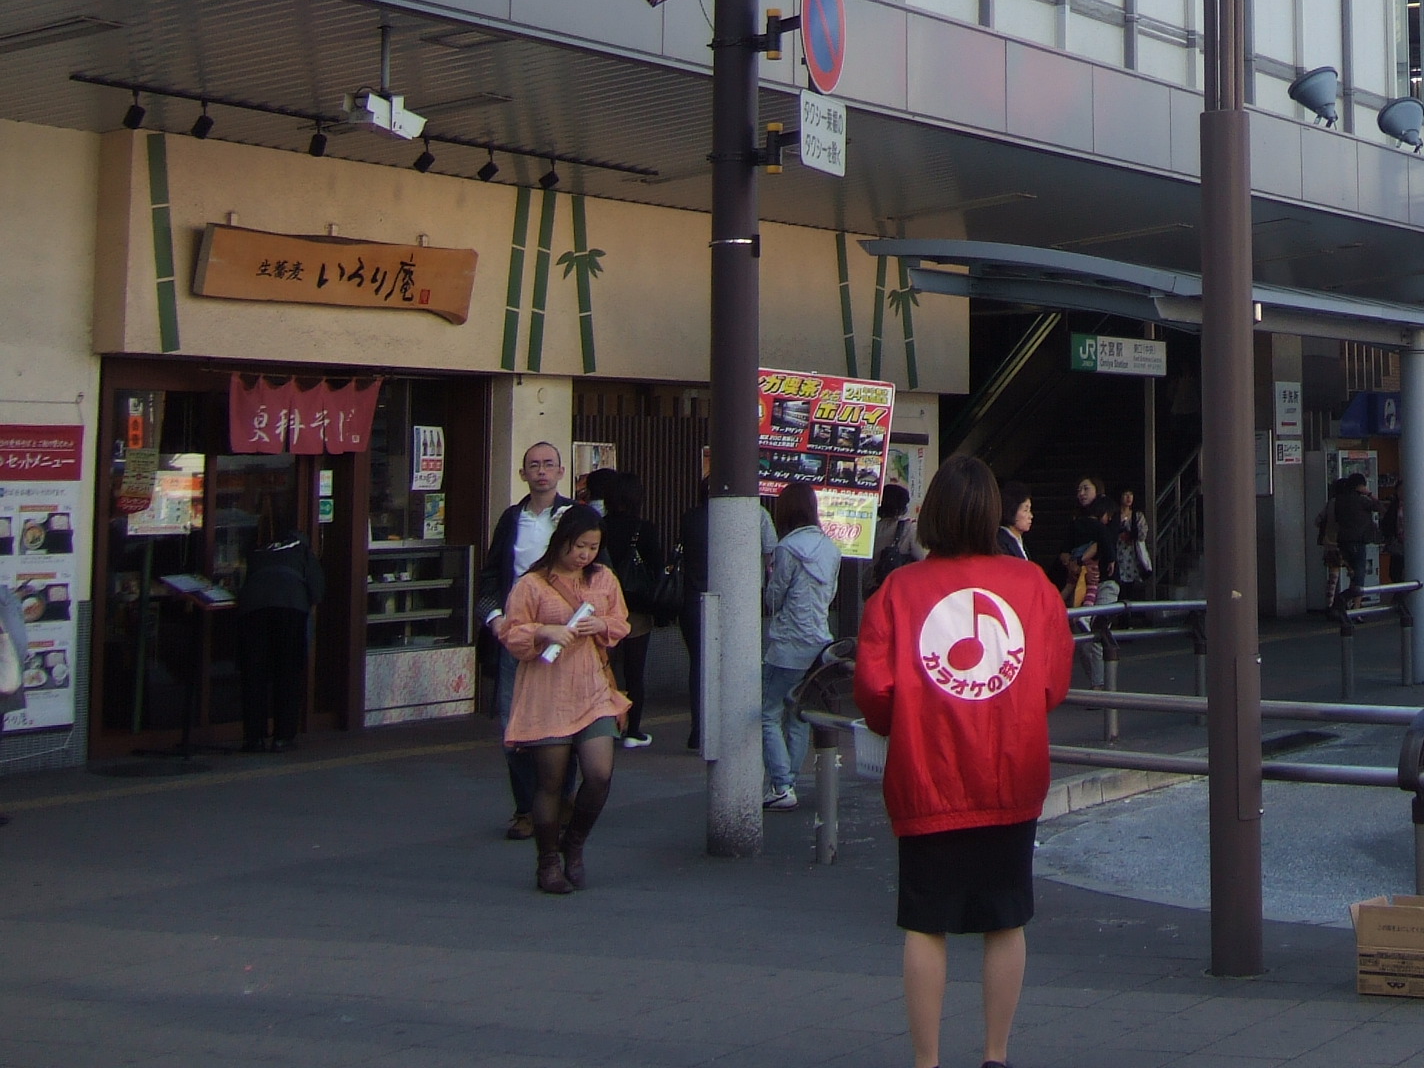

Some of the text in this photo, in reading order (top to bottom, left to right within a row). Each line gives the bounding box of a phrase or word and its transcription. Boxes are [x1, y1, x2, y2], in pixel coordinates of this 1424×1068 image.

[316, 253, 417, 303] いろり庵
[1079, 339, 1096, 360] JR
